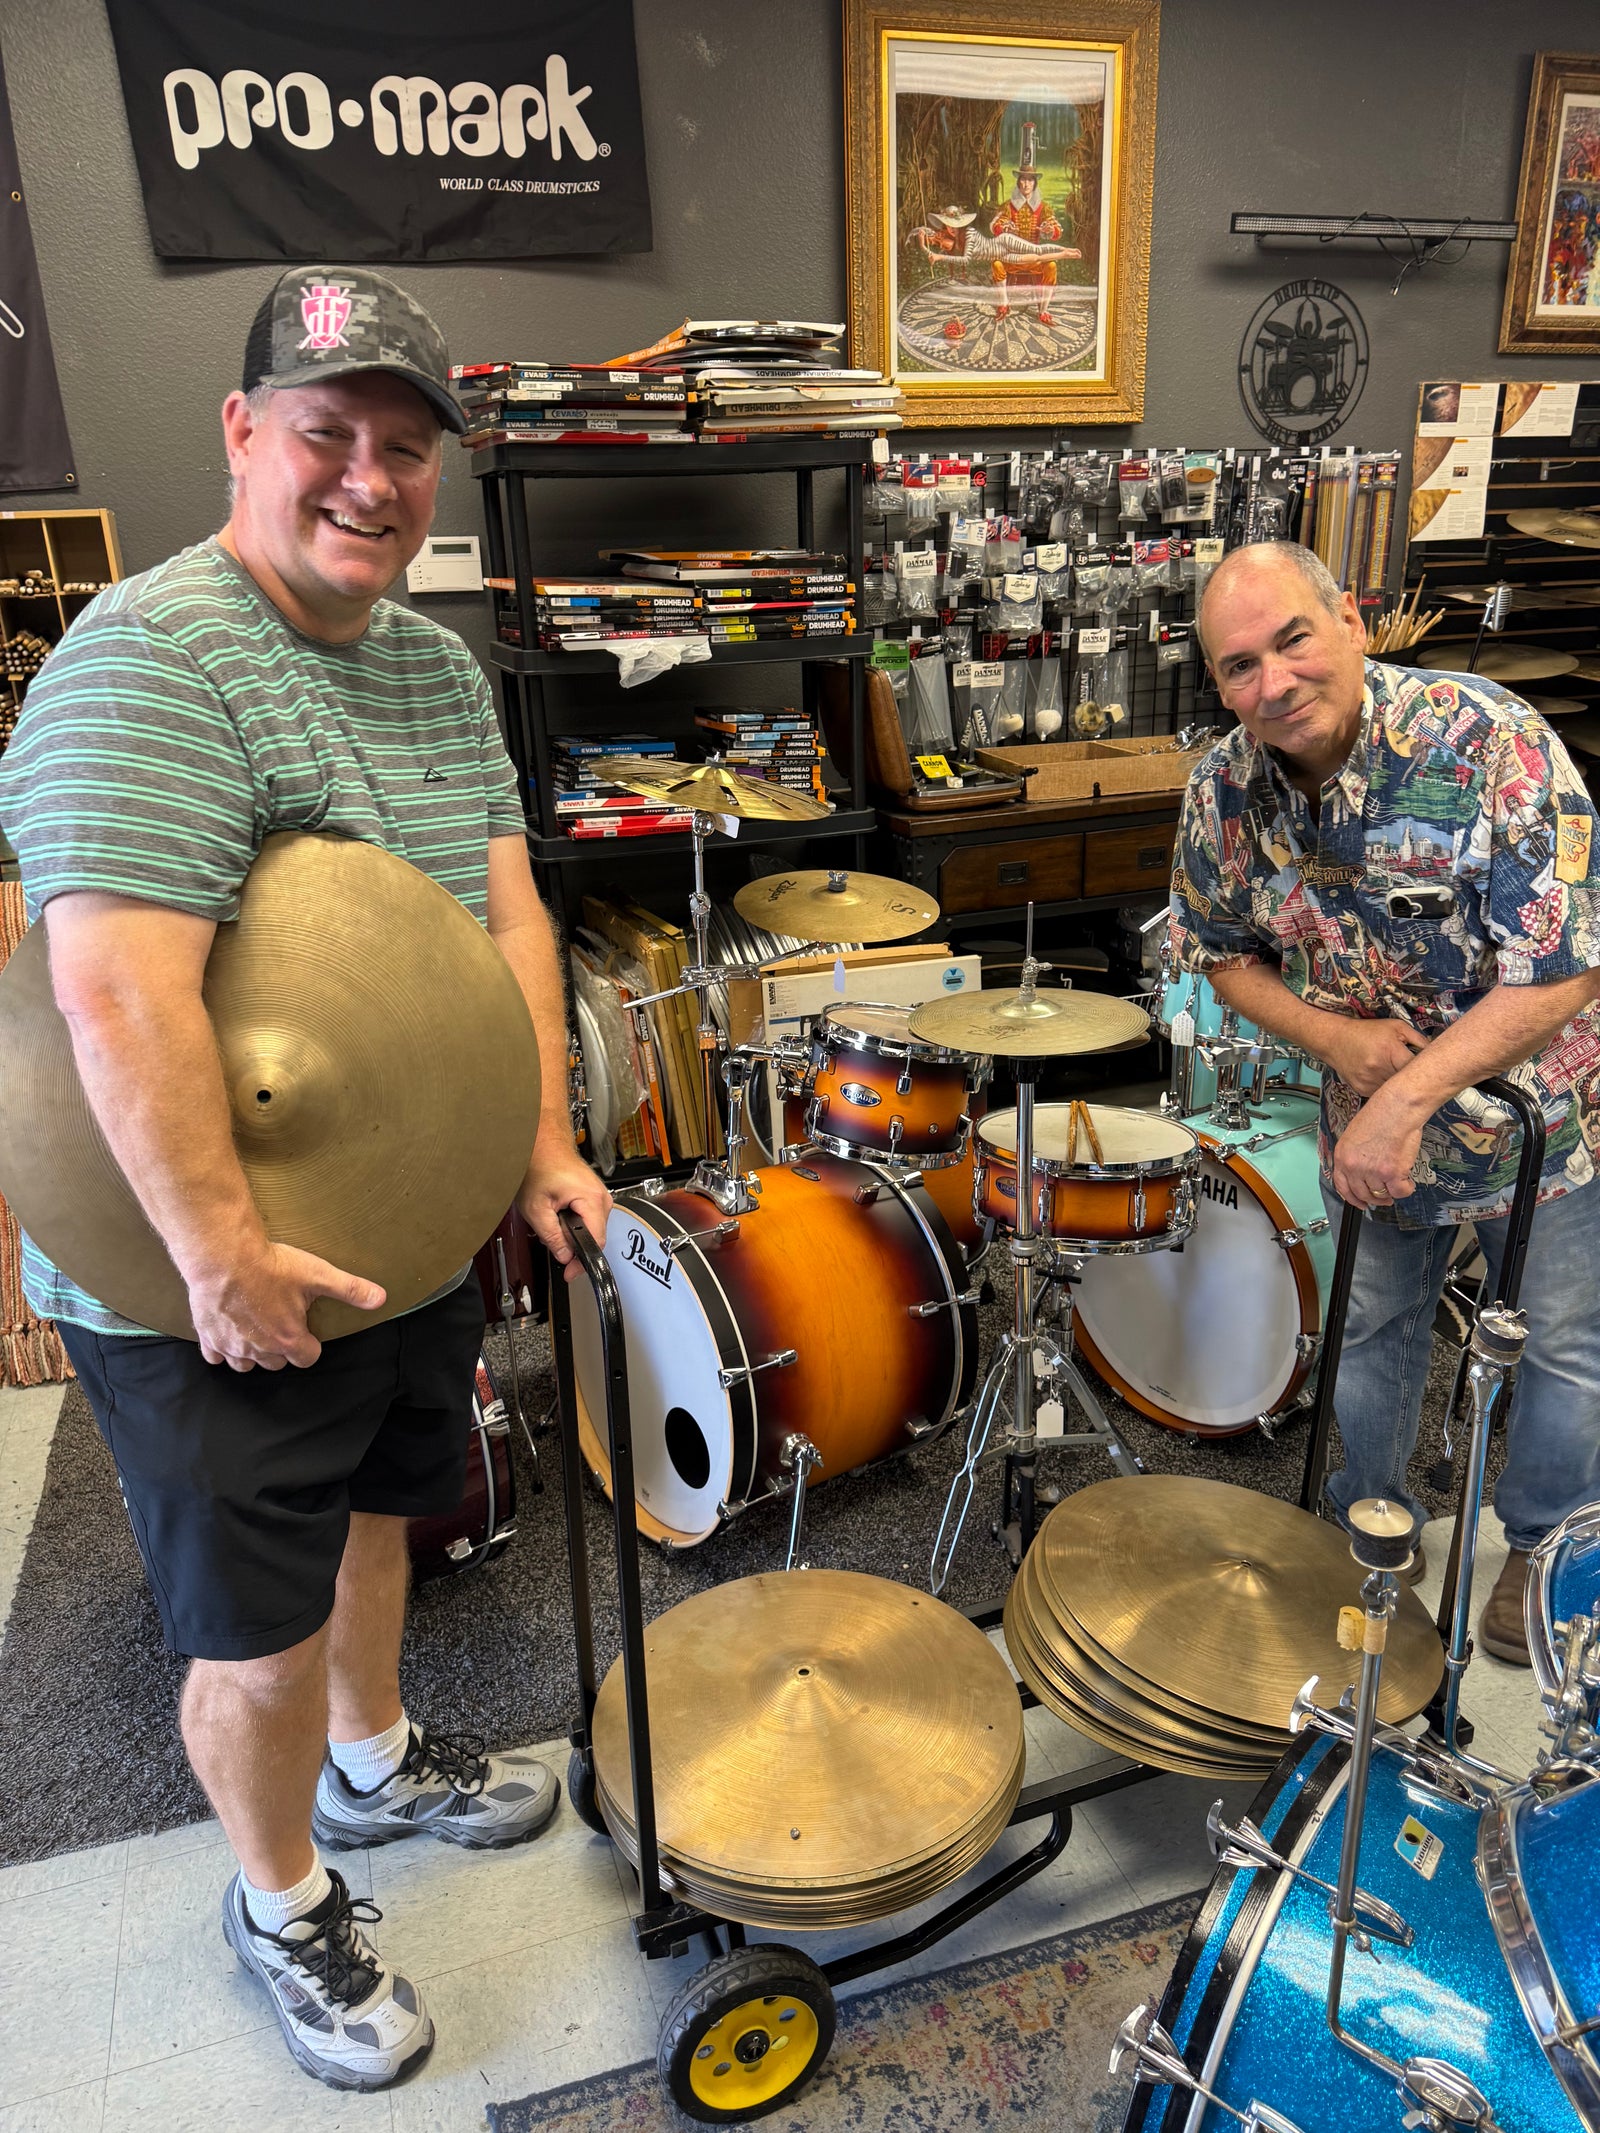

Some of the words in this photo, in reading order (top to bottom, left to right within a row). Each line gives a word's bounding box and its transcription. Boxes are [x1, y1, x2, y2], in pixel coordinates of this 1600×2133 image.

[439, 177, 484, 191] WORLD
[487, 178, 524, 193] CLASS
[525, 180, 601, 194] DRUMSTICKS
[1274, 281, 1308, 306] DRUM
[1313, 281, 1341, 301] FLIP
[523, 371, 549, 379] EVANS
[643, 393, 685, 401] DRUMHEAD
[731, 403, 781, 412] DRUMHEAD
[554, 409, 585, 418] EVANS
[838, 430, 876, 439] DRUMHEAD
[1271, 467, 1287, 480] dw
[751, 569, 791, 577] DRUMHEAD
[806, 575, 844, 584] DRUMHEAD
[807, 586, 845, 594] DRUMHEAD
[803, 613, 840, 621] DRUMHEAD
[809, 621, 846, 629] DRUMHEAD
[807, 629, 842, 637] DRUMHEAD
[875, 656, 908, 664] ENFORCER
[974, 668, 1002, 678] DANMAR
[768, 982, 776, 1005] EVANS
[638, 1012, 649, 1042] REMO
[621, 1229, 673, 1282] Pearl
